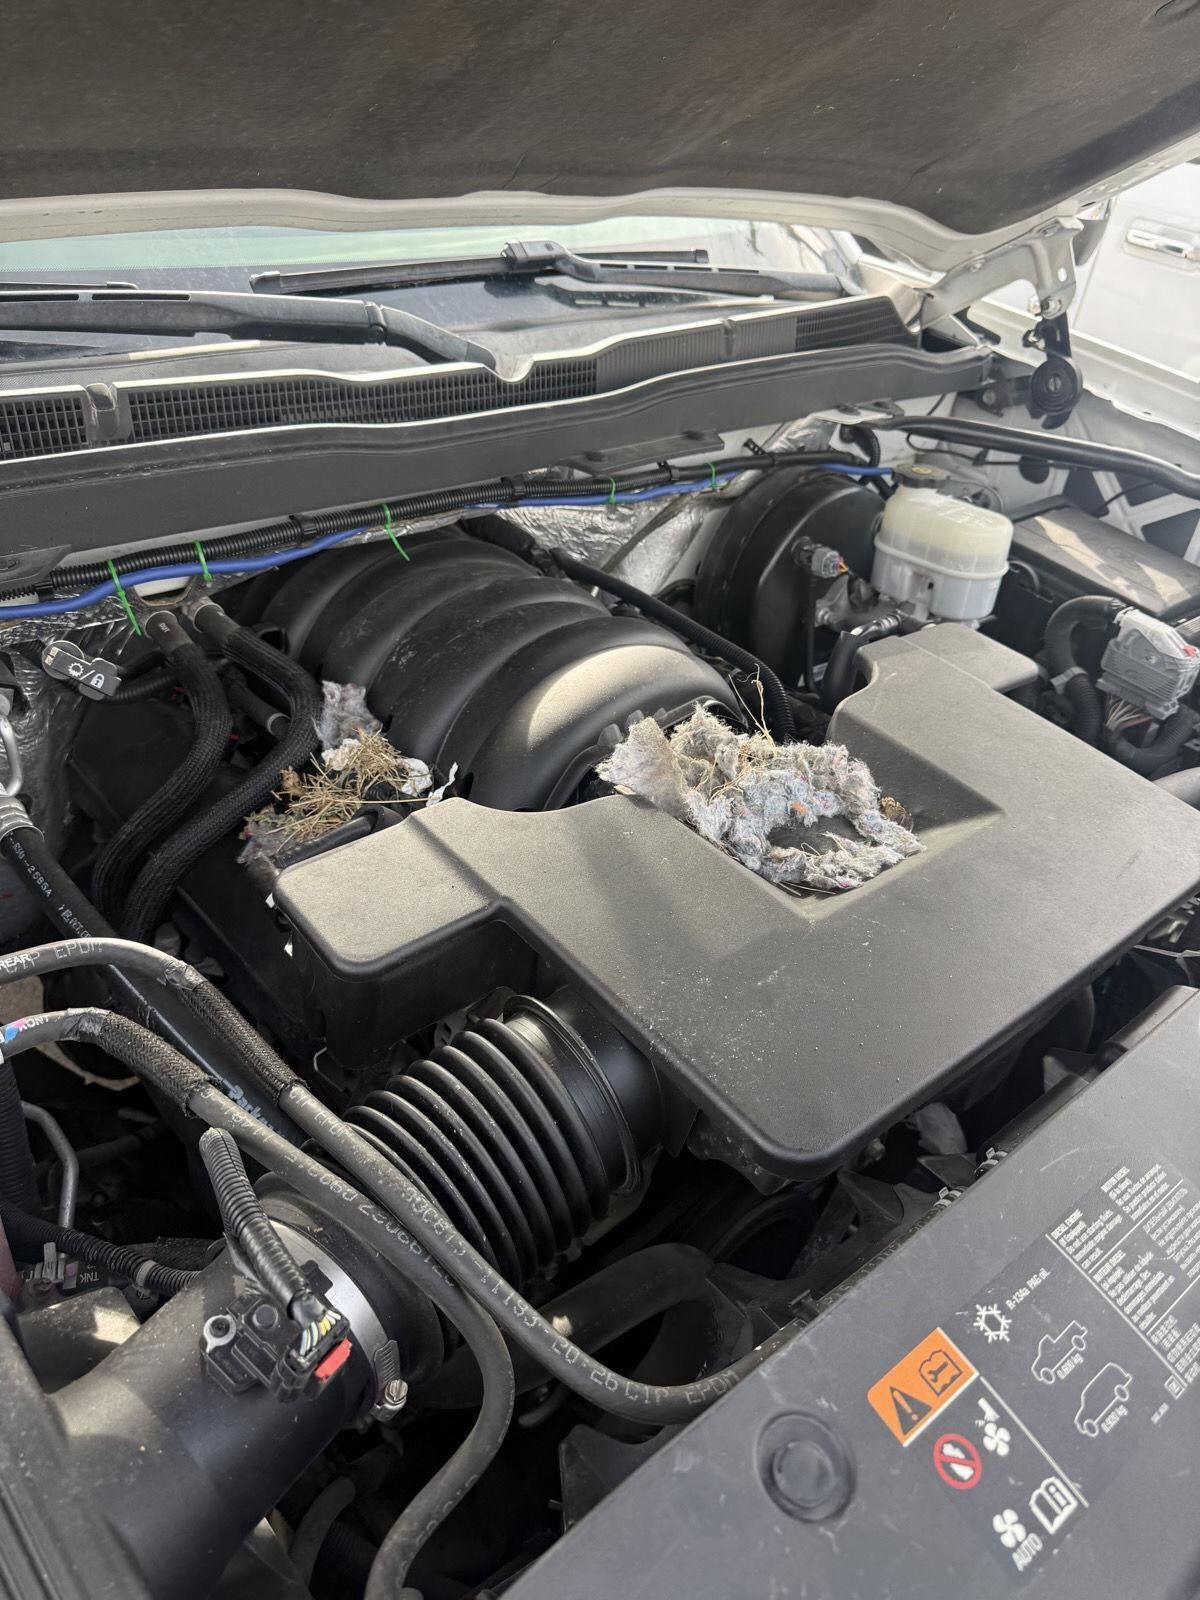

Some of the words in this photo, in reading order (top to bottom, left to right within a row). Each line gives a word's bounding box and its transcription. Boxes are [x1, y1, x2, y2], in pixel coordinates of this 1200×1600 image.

[79, 1271, 98, 1282] TNK
[1004, 1284, 1031, 1310] R-134a
[1026, 1273, 1042, 1290] PAG
[685, 1369, 741, 1405] EPDM
[1006, 1531, 1047, 1572] AUTO
